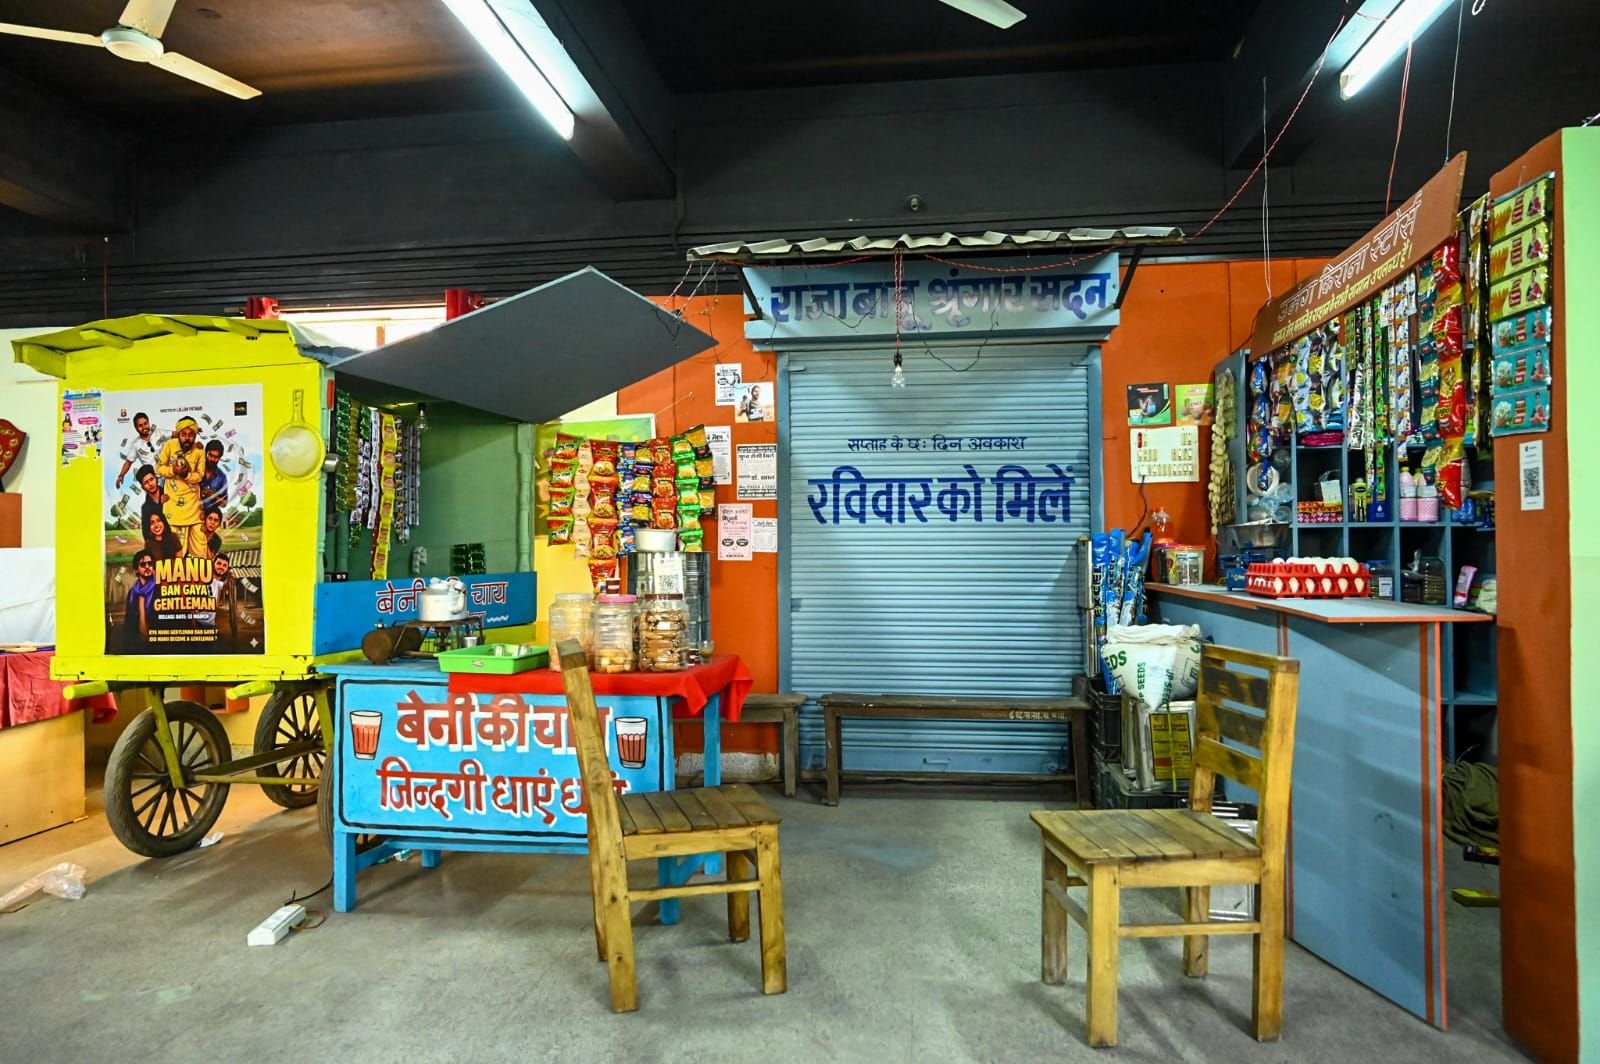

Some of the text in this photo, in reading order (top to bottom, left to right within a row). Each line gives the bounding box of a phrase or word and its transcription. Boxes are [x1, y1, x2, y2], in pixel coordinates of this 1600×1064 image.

[1318, 242, 1370, 299] किराना
[1370, 252, 1401, 285] उपलब्ध
[770, 283, 851, 322] राजा
[850, 278, 932, 331] बाबू
[1028, 272, 1112, 320] सदन
[848, 437, 888, 452] सप्ताह
[890, 435, 904, 451] के
[932, 434, 962, 452] दिन
[968, 436, 1028, 452] अवकाश
[807, 463, 1076, 526] रविवार को मिलें
[155, 557, 212, 585] MANU
[154, 598, 215, 611] GENTLEMAN
[161, 585, 207, 596] BAN GAYA
[470, 581, 509, 606] चाय
[1137, 662, 1146, 690] SEEDS
[396, 690, 612, 757] बेनी की चा
[376, 757, 491, 821] जिन्दगी
[491, 769, 559, 827] धाएं
